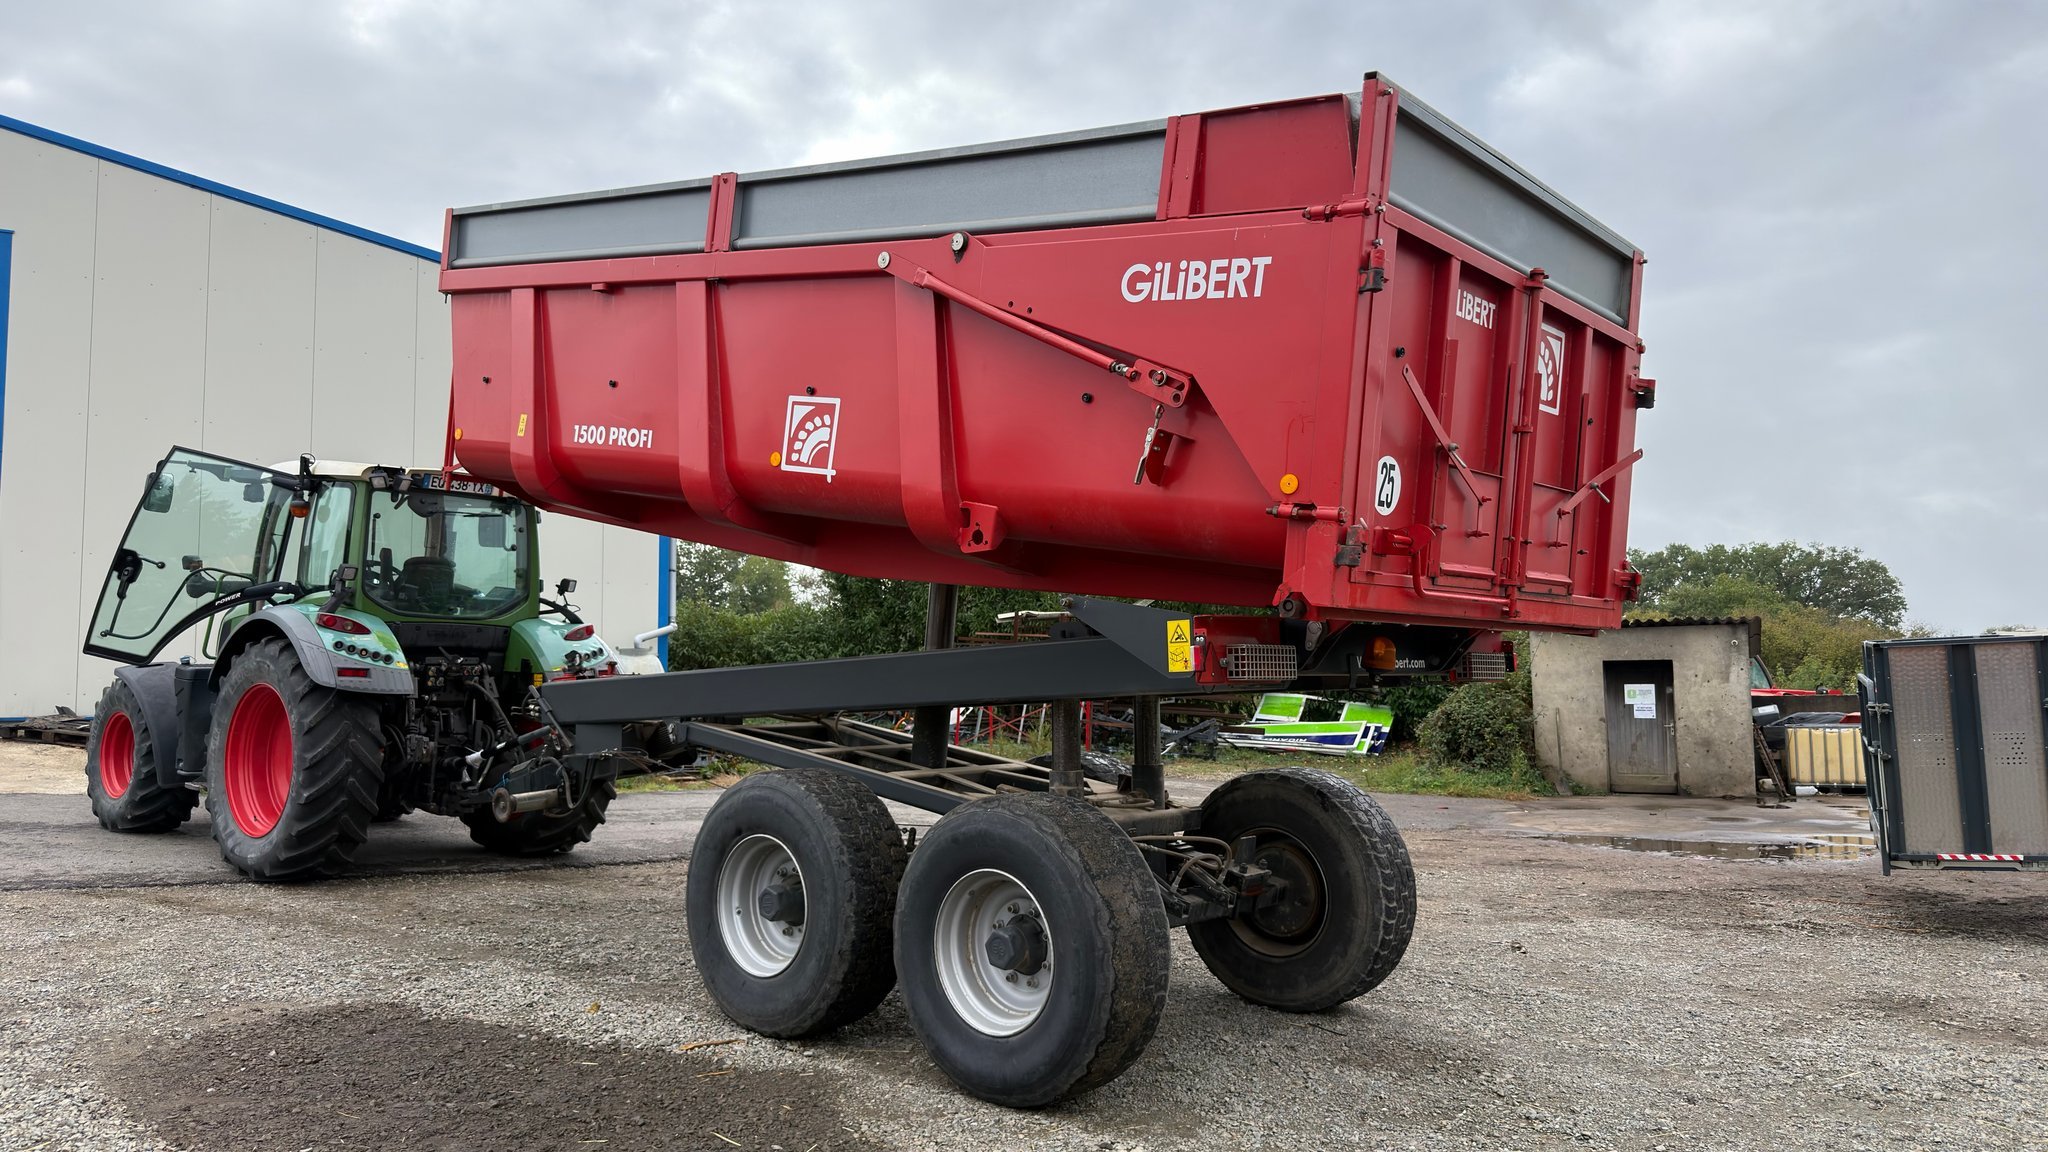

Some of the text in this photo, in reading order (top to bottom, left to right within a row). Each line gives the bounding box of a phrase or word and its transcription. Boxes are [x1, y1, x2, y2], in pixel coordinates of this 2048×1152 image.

[1121, 256, 1272, 302] GiLiBERT
[1456, 289, 1496, 329] LiBERT
[574, 425, 653, 448] 1500 PROFI
[1378, 462, 1396, 508] 25
[215, 592, 242, 606] POWER
